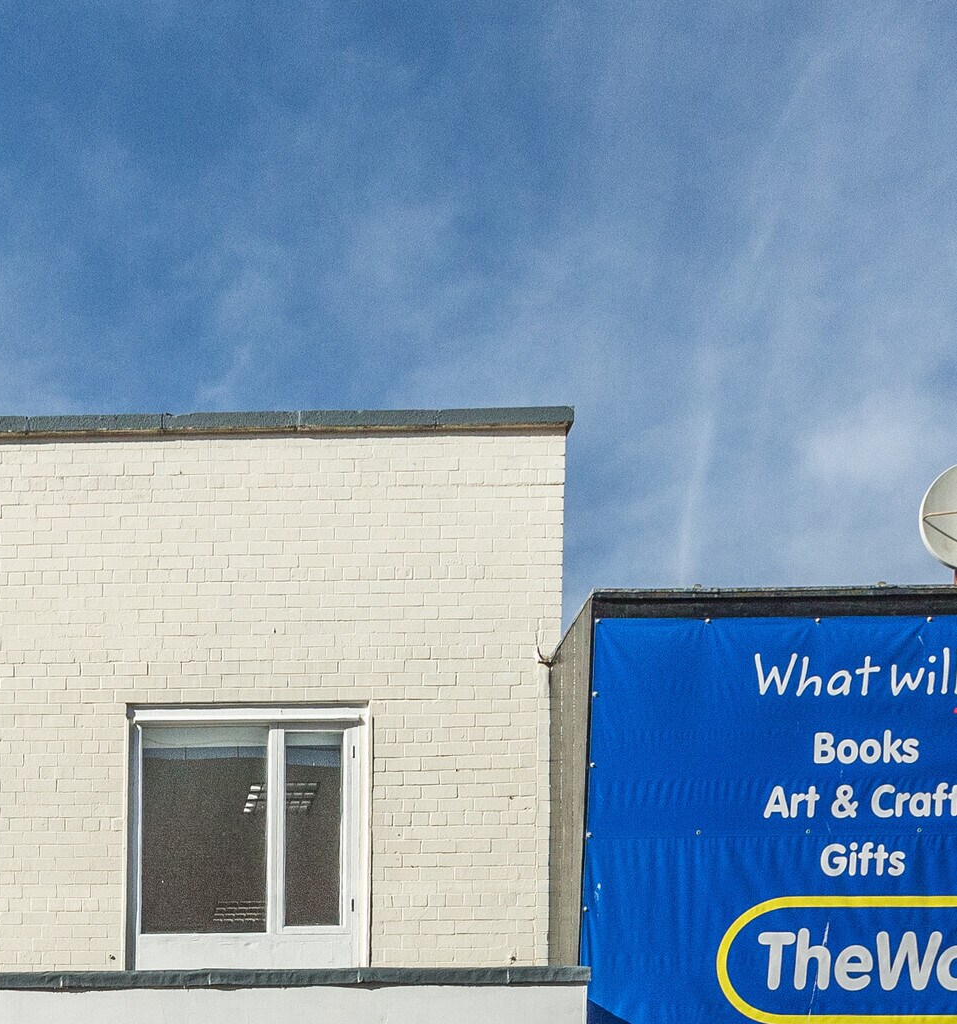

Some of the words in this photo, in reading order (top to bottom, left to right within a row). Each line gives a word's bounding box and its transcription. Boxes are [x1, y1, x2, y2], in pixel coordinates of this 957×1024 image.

[754, 653, 881, 697] What
[890, 647, 957, 697] wil
[813, 729, 920, 765] Books
[764, 786, 820, 819] Art
[831, 784, 858, 819] &
[820, 842, 906, 877] Gifts
